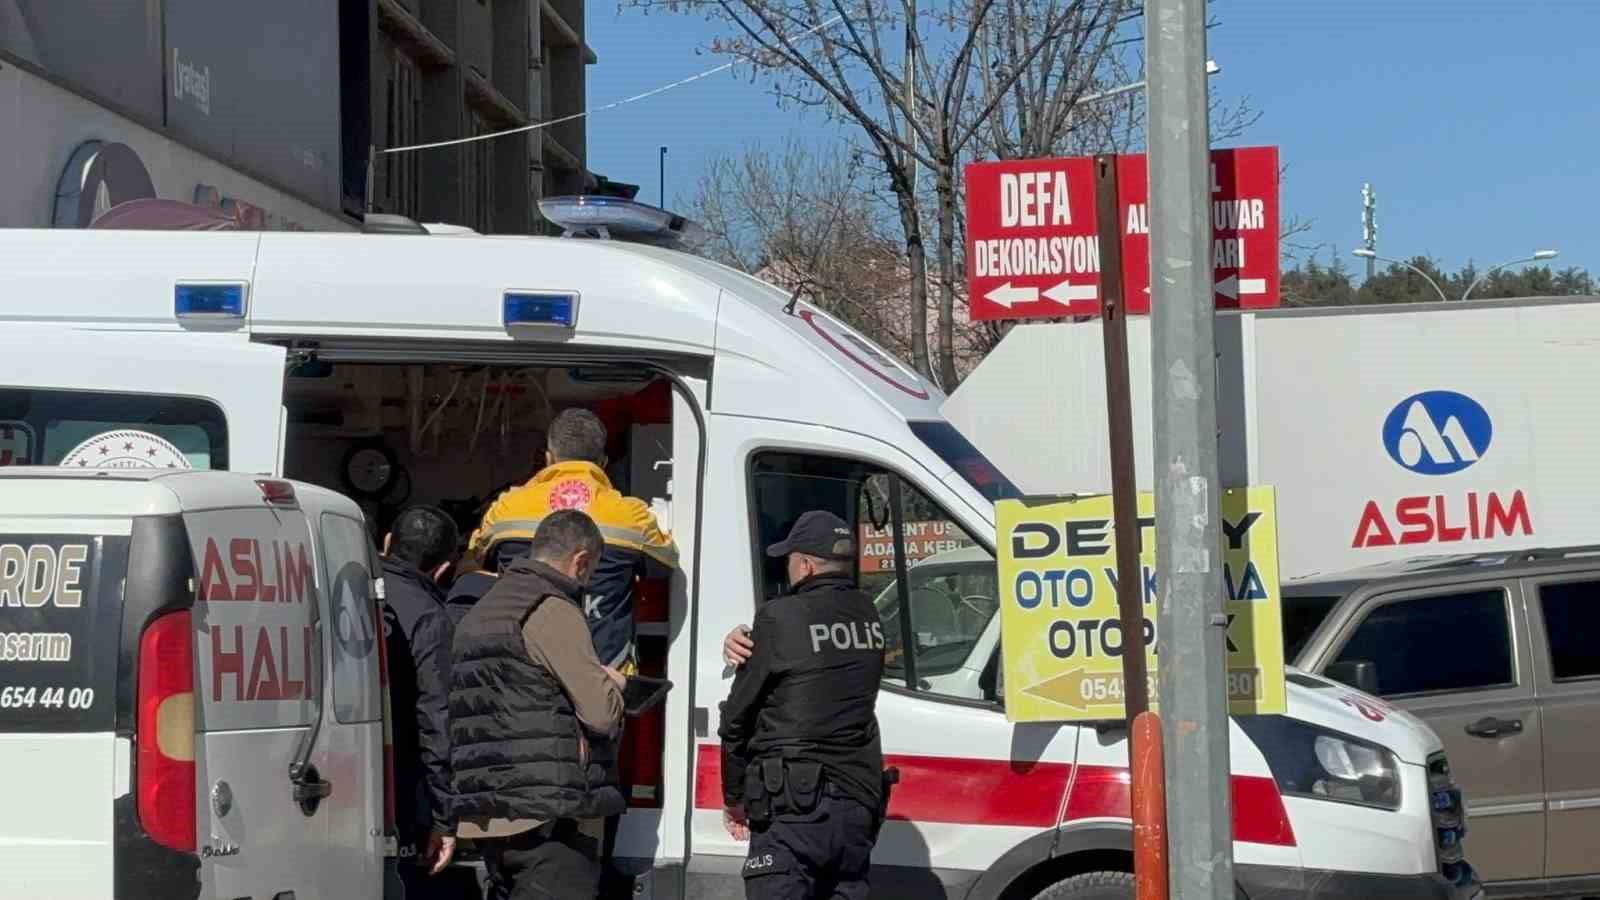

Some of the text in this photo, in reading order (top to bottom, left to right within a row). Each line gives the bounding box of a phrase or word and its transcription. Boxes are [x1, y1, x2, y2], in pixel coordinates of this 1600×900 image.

[1000, 171, 1072, 227] DEFA
[1213, 198, 1265, 231] UVAR
[975, 235, 1101, 276] DEKORASYON
[1351, 489, 1534, 548] ASLIM
[198, 536, 311, 603] ASLIM
[1015, 568, 1093, 610] OTO
[211, 624, 313, 702] HALI
[0, 686, 94, 710] 654 44 00
